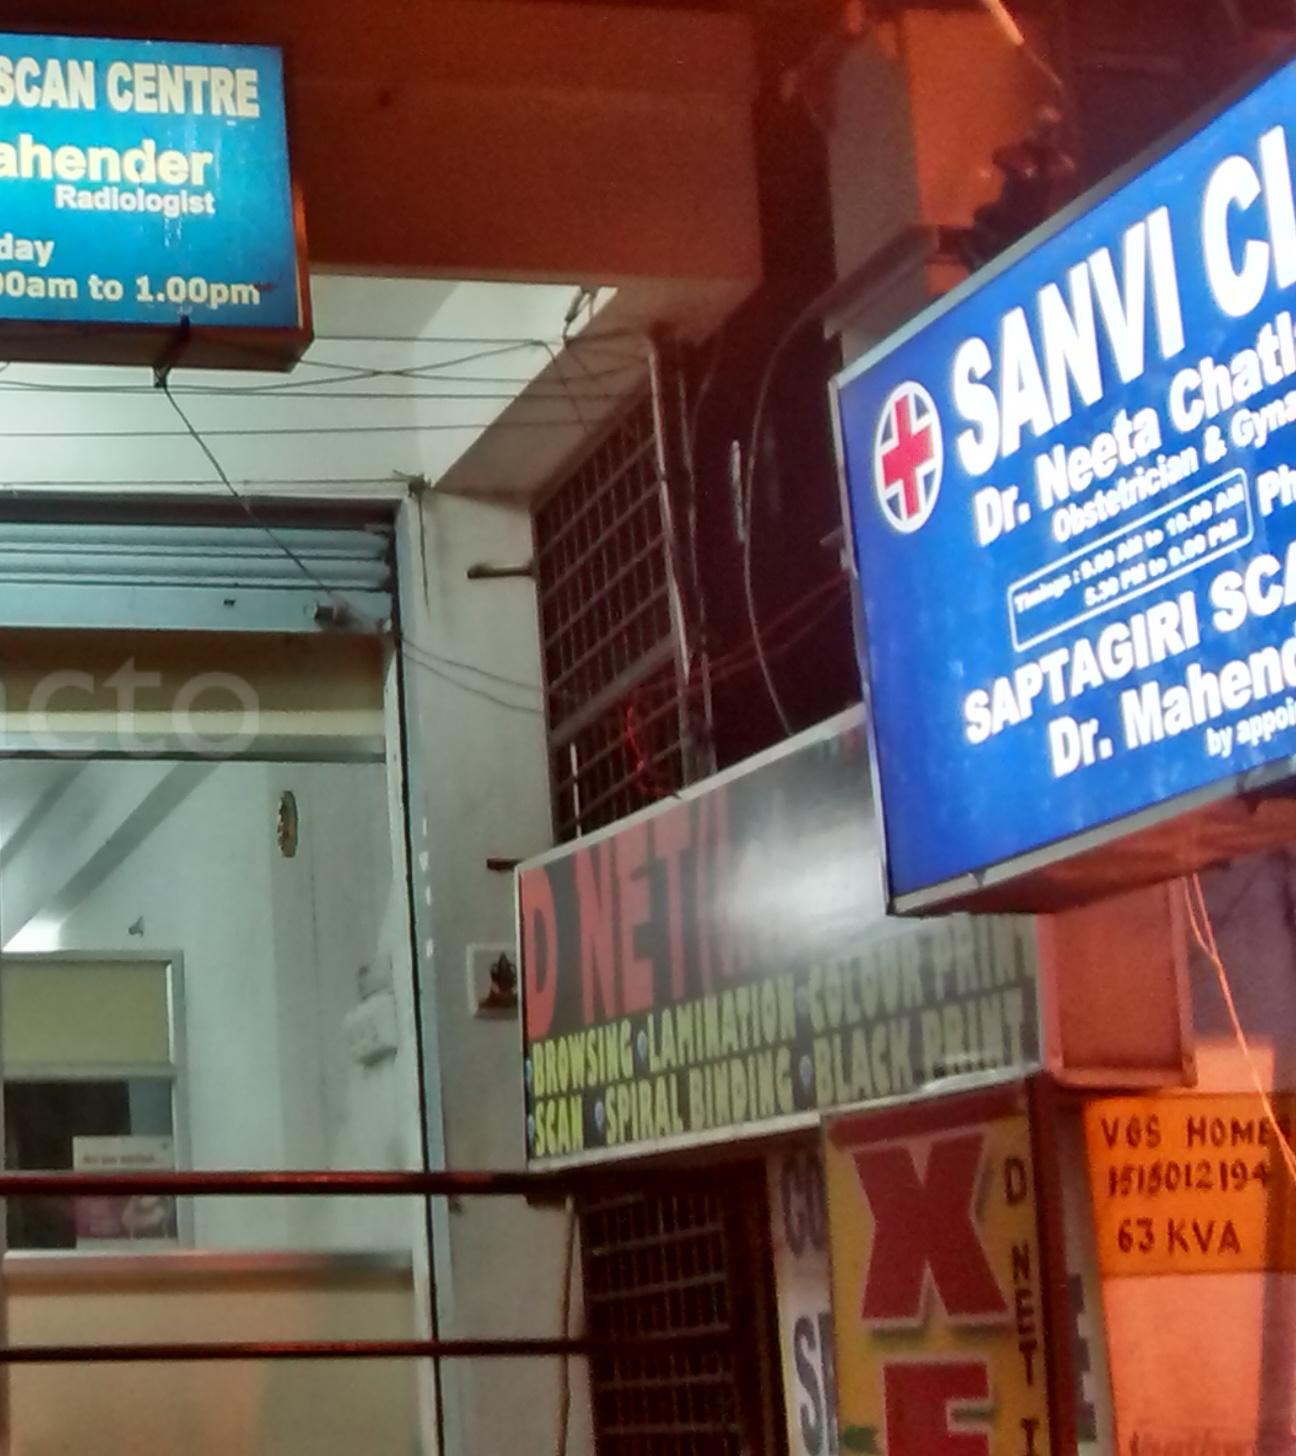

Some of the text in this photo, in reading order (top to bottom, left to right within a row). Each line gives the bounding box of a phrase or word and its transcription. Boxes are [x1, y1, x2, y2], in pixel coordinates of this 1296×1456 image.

[107, 61, 261, 118] CENTRE
[54, 183, 216, 217] Radiologist
[88, 275, 124, 302] to
[136, 276, 260, 311] 1.00pm
[953, 206, 1185, 476] SANVI
[974, 484, 1031, 547] Dr.
[1035, 406, 1162, 510] Neeta
[1052, 452, 1199, 542] Obstetrician
[1204, 425, 1228, 463] &
[1145, 528, 1164, 548] to
[1215, 483, 1245, 513] AM
[1120, 562, 1147, 590] PM
[1148, 557, 1167, 577] to
[1207, 517, 1237, 548] PM
[965, 590, 1200, 745] SAPTAGIRI
[1049, 716, 1113, 778] Dr.
[1207, 726, 1233, 758] by
[532, 1018, 633, 1097] BROWSING
[647, 974, 796, 1073] LAMINATION
[536, 986, 1023, 1157] SCAN SPIRAL BINDING BLACK PRINT
[1118, 1217, 1242, 1255] 63 KVA
